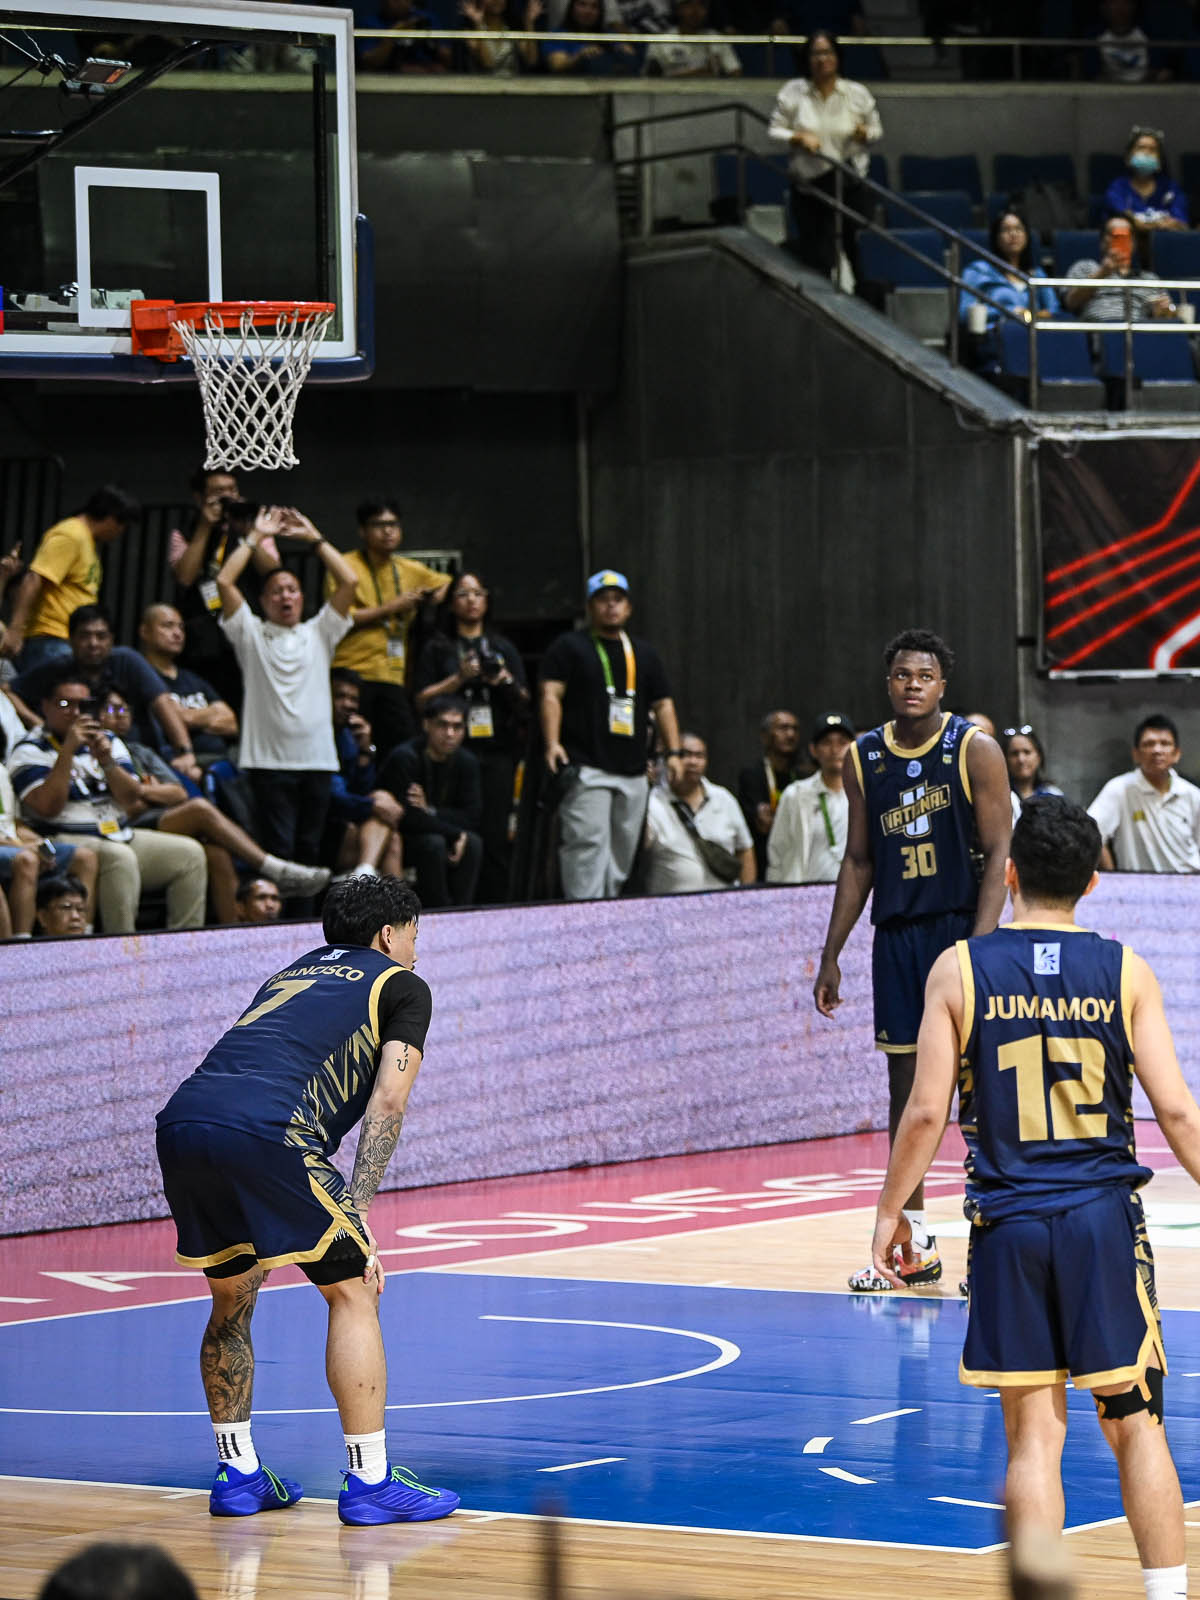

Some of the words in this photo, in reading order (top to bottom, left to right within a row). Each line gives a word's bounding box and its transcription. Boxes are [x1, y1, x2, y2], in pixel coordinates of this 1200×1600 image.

[901, 843, 937, 879] 30
[265, 964, 365, 988] FRANCISCO
[234, 979, 318, 1027] 7
[984, 995, 1116, 1023] JUMAMOY
[997, 1034, 1109, 1142] 12
